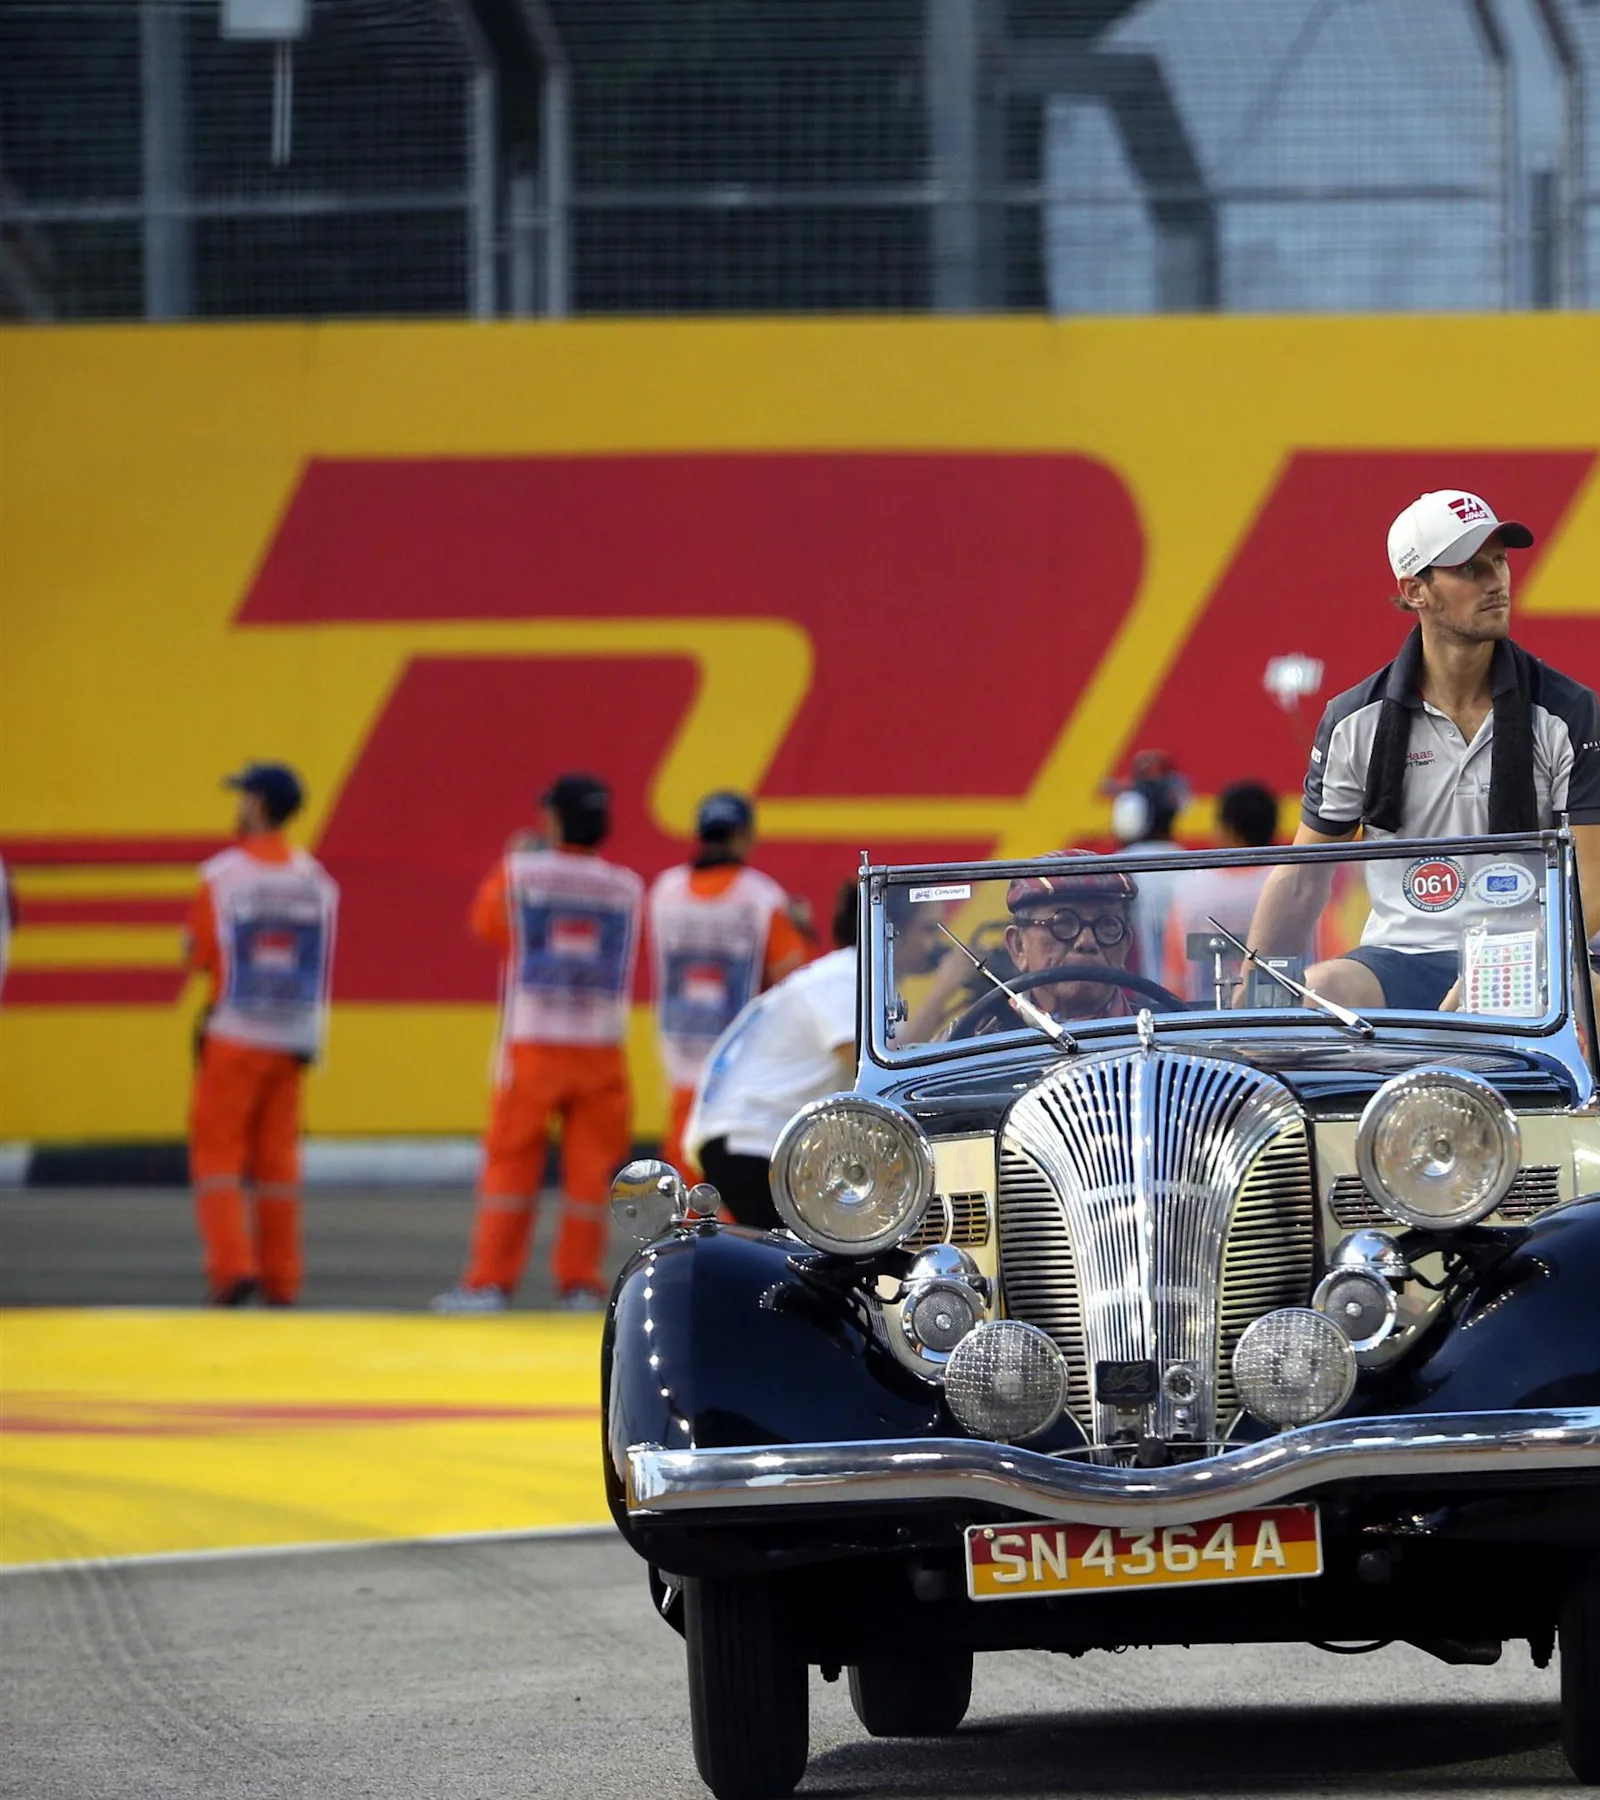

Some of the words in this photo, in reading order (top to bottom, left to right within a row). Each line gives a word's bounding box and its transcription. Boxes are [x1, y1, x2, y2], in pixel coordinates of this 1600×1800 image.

[1463, 510, 1485, 522] HAAS
[1413, 873, 1453, 896] 061
[990, 1531, 1069, 1583] SN
[1081, 1522, 1237, 1578] 4364
[1251, 1519, 1287, 1569] A
